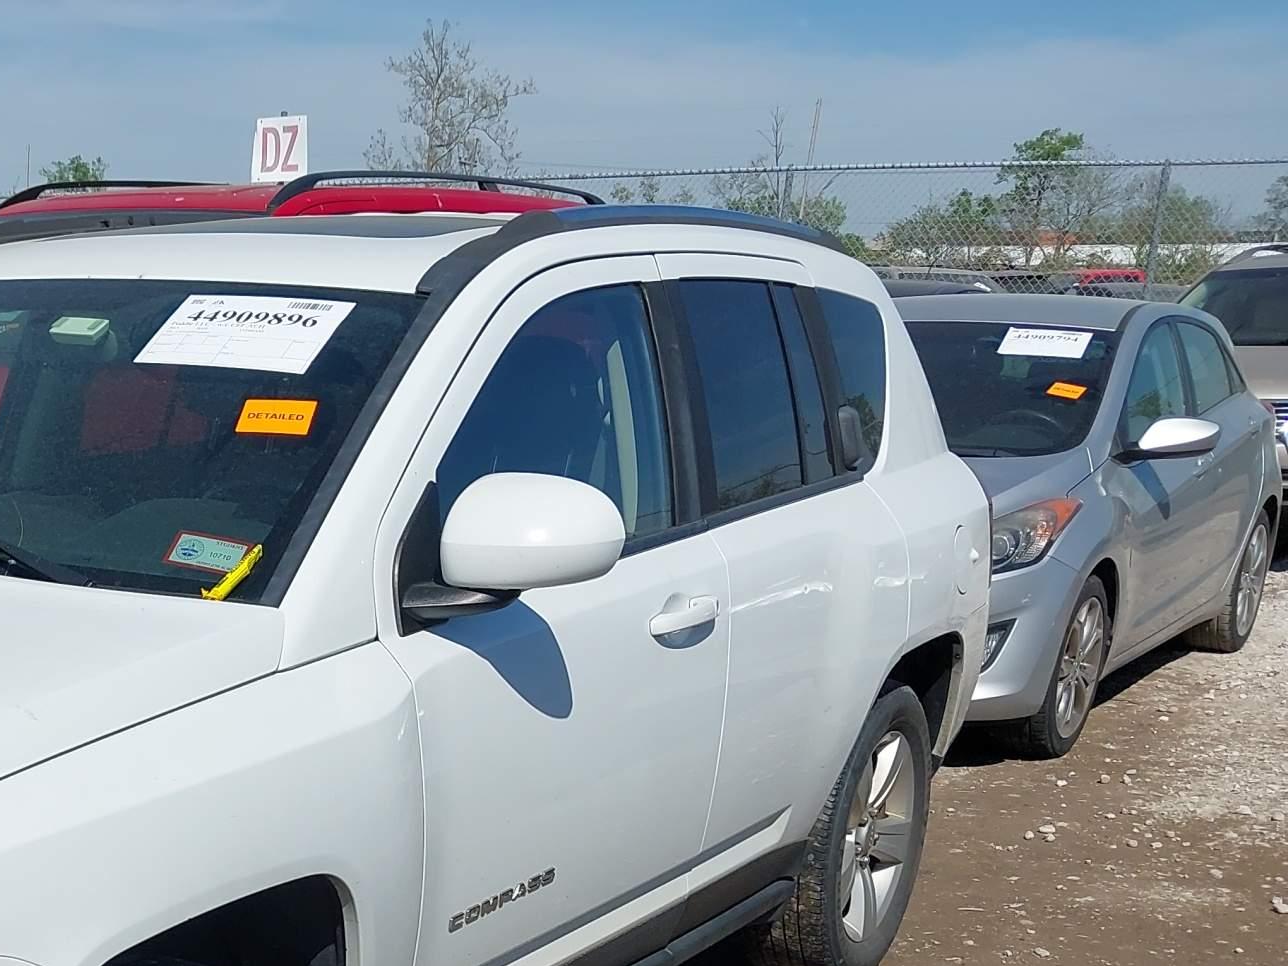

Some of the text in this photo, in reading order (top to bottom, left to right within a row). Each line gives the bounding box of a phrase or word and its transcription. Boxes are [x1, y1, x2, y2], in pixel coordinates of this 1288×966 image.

[260, 125, 299, 173] DZ
[187, 309, 320, 328] 44909896
[247, 412, 305, 421] DETAILED
[448, 866, 557, 934] COMPASS
